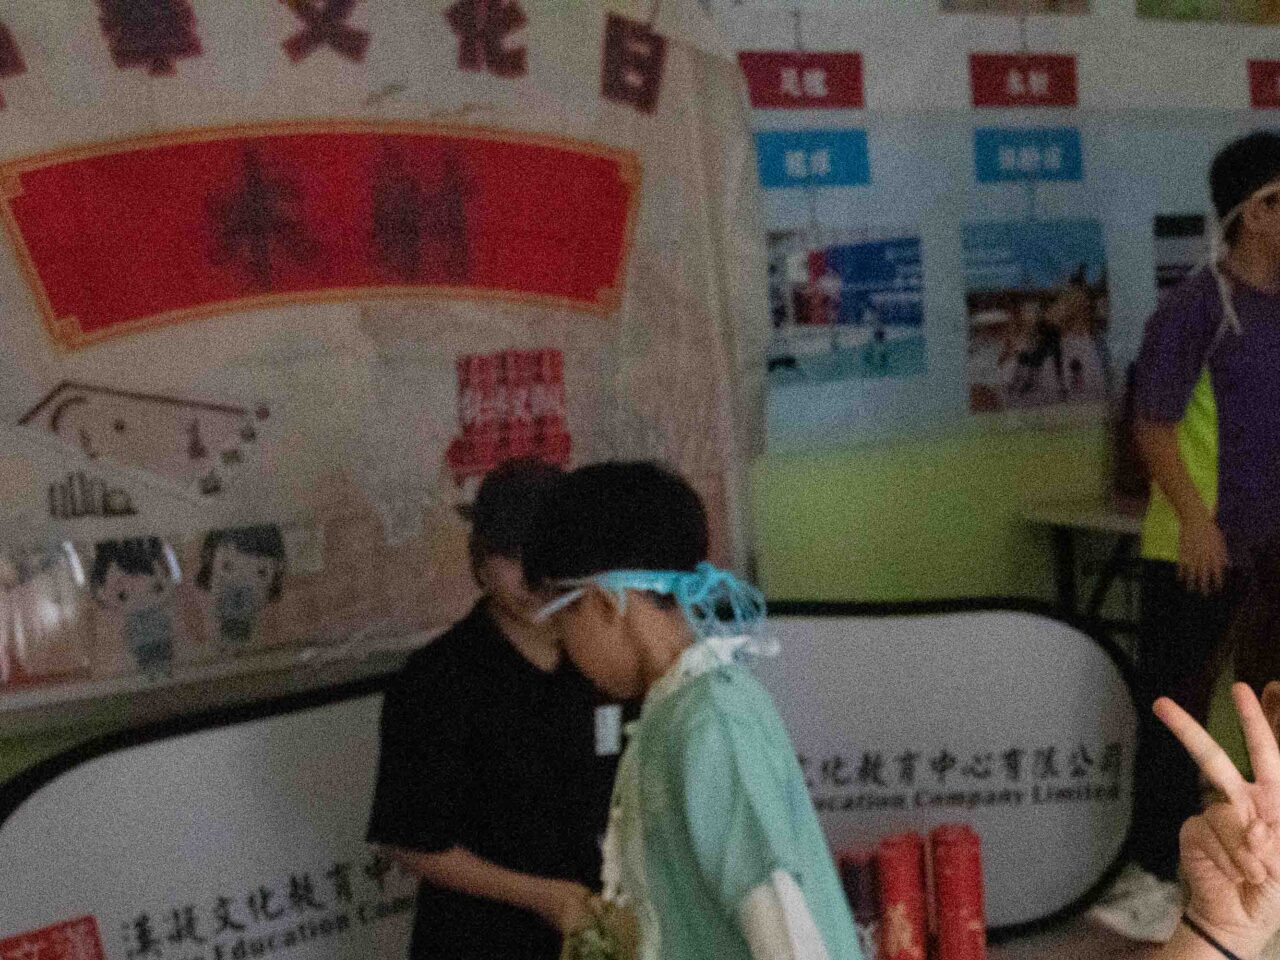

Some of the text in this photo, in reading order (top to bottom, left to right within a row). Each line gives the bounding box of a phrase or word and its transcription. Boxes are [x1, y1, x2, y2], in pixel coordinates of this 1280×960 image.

[814, 781, 1121, 812] ucation Company Limited
